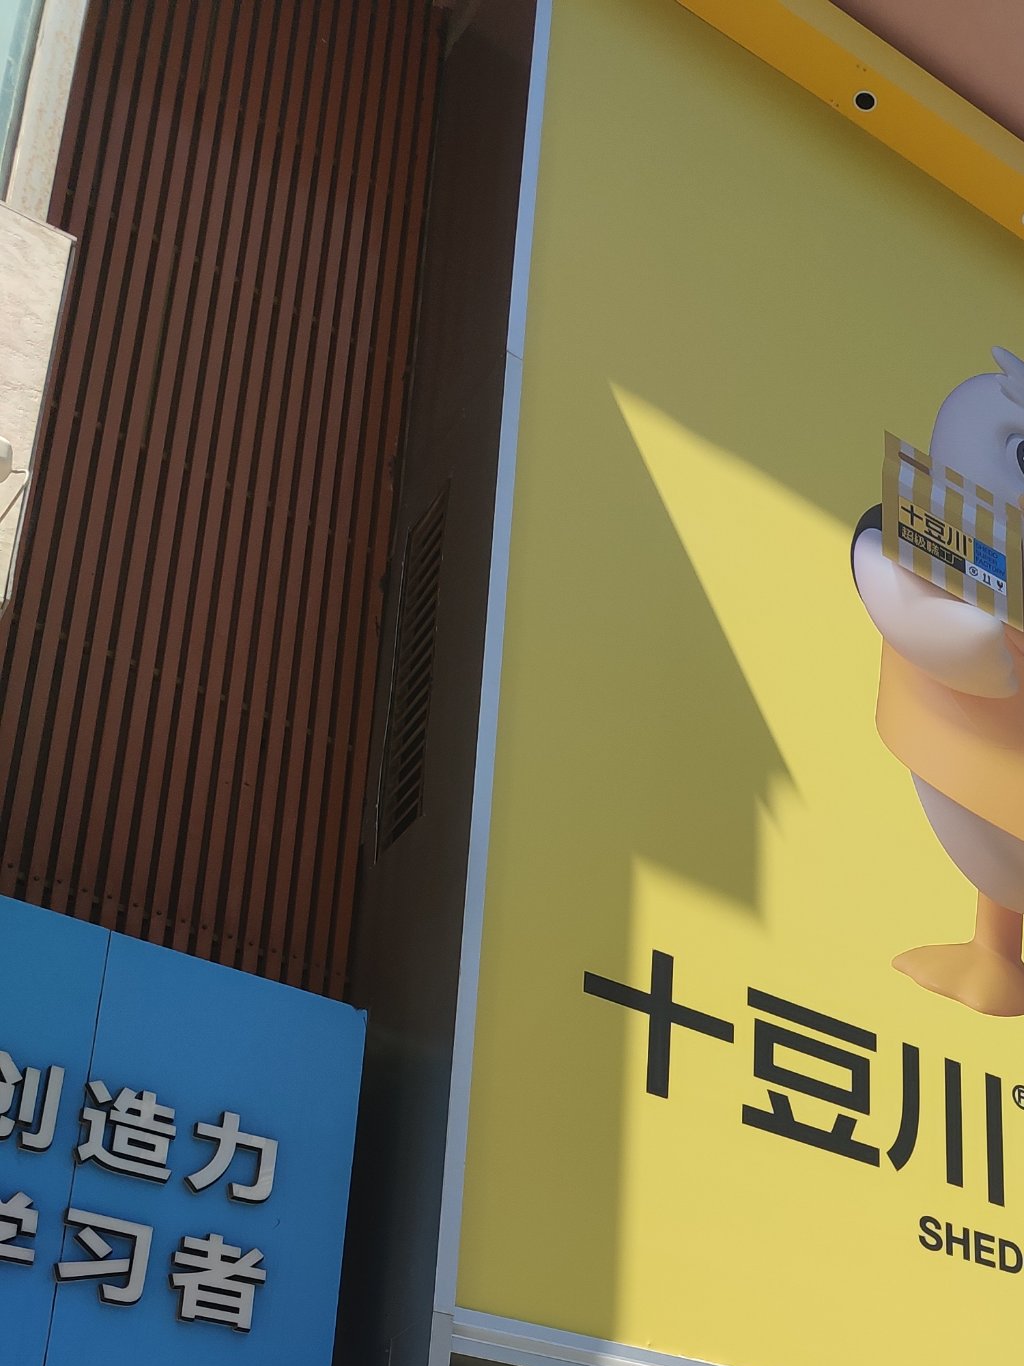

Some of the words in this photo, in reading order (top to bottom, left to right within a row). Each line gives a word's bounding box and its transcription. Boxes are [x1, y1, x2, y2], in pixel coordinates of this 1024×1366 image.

[901, 504, 968, 557] 十豆川
[0, 1052, 279, 1205] 创造力
